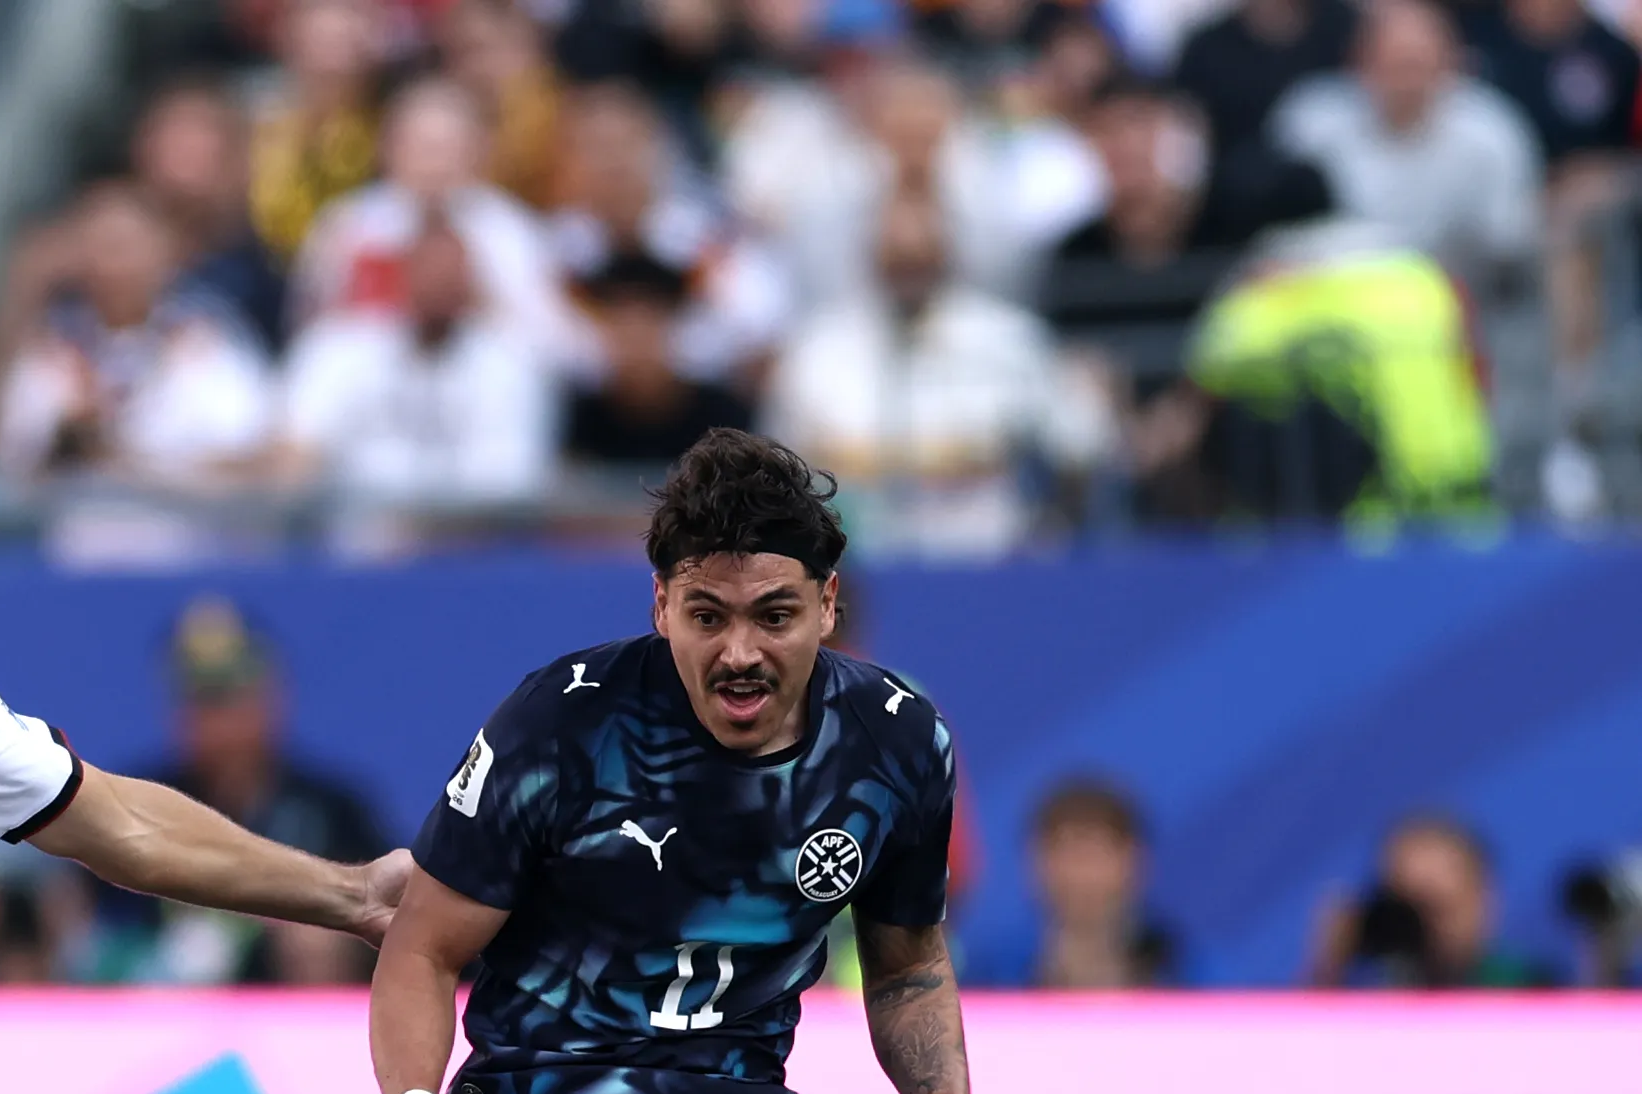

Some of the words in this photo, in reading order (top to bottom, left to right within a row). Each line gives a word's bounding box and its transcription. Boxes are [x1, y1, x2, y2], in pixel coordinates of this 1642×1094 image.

[821, 835, 845, 849] APF
[808, 887, 839, 898] PARAGUAY
[649, 941, 736, 1031] 11
